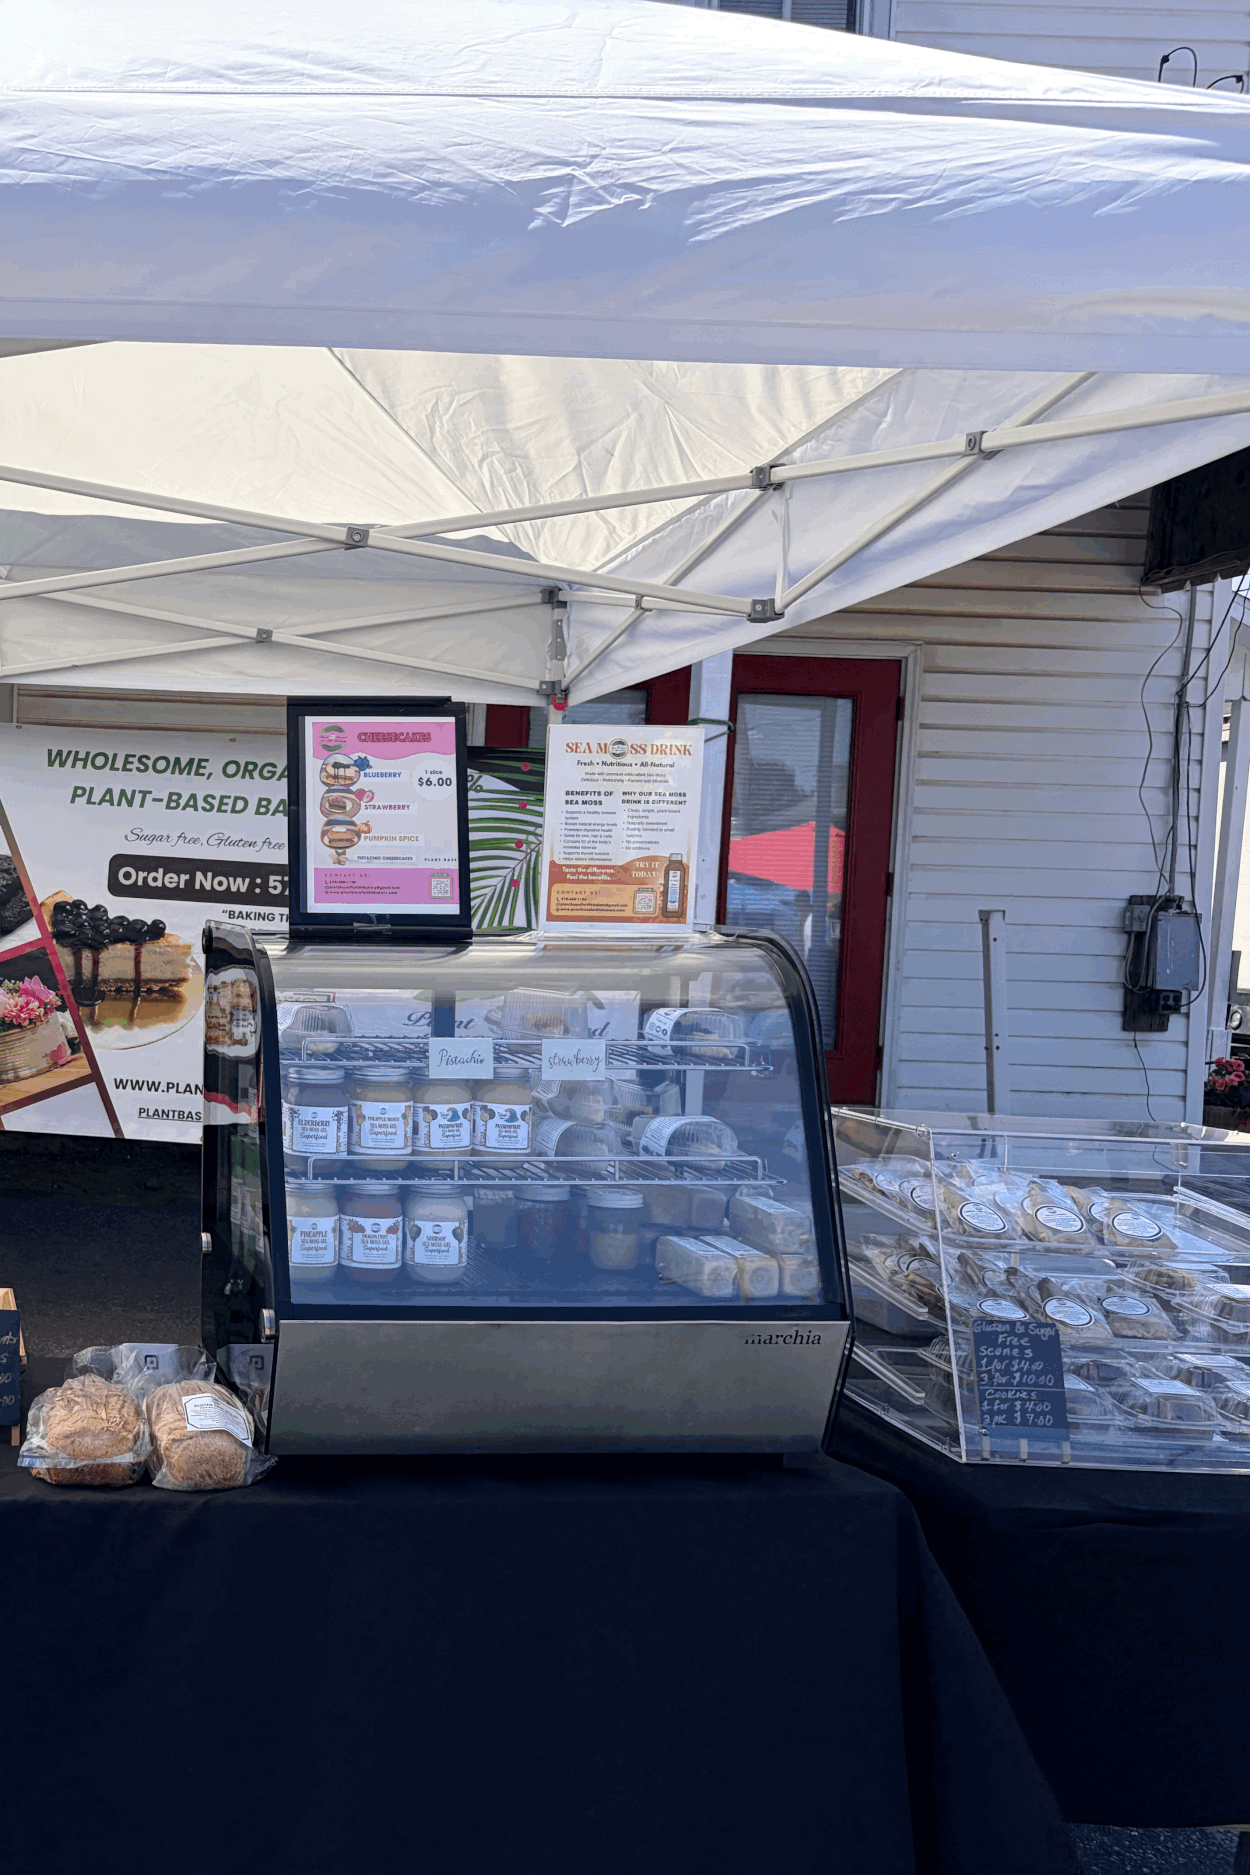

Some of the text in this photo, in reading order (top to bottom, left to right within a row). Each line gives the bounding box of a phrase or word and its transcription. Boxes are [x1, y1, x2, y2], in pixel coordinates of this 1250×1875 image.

[357, 732, 432, 743] CHEESECAKES
[565, 742, 593, 754] SEA
[650, 743, 692, 756] DRINK
[47, 749, 213, 779] WHOLESOME,
[417, 777, 452, 787] $6.00
[70, 785, 248, 814] PLANT-BASED
[124, 827, 171, 846] Sugar
[206, 832, 259, 848] Gluten
[255, 837, 286, 852] free
[118, 866, 190, 889] Order
[195, 872, 250, 892] Now
[437, 1049, 485, 1067] Pistachio
[548, 1049, 603, 1074] strawberry
[298, 1119, 330, 1127] ELDERBERRY
[300, 1132, 328, 1141] Superfood
[369, 1129, 397, 1137] Superfood
[300, 1230, 328, 1238] PINEAPPLE
[300, 1244, 327, 1252] Superfood
[973, 1321, 1010, 1332] Gluten
[1015, 1322, 1025, 1333] &
[998, 1334, 1031, 1346] Free
[979, 1345, 1033, 1358] Scones
[989, 1359, 1009, 1375] for
[980, 1373, 988, 1384] 3
[993, 1372, 1009, 1386] for
[985, 1389, 1037, 1399] Cookies
[981, 1401, 991, 1412] 1
[993, 1400, 1009, 1412] for
